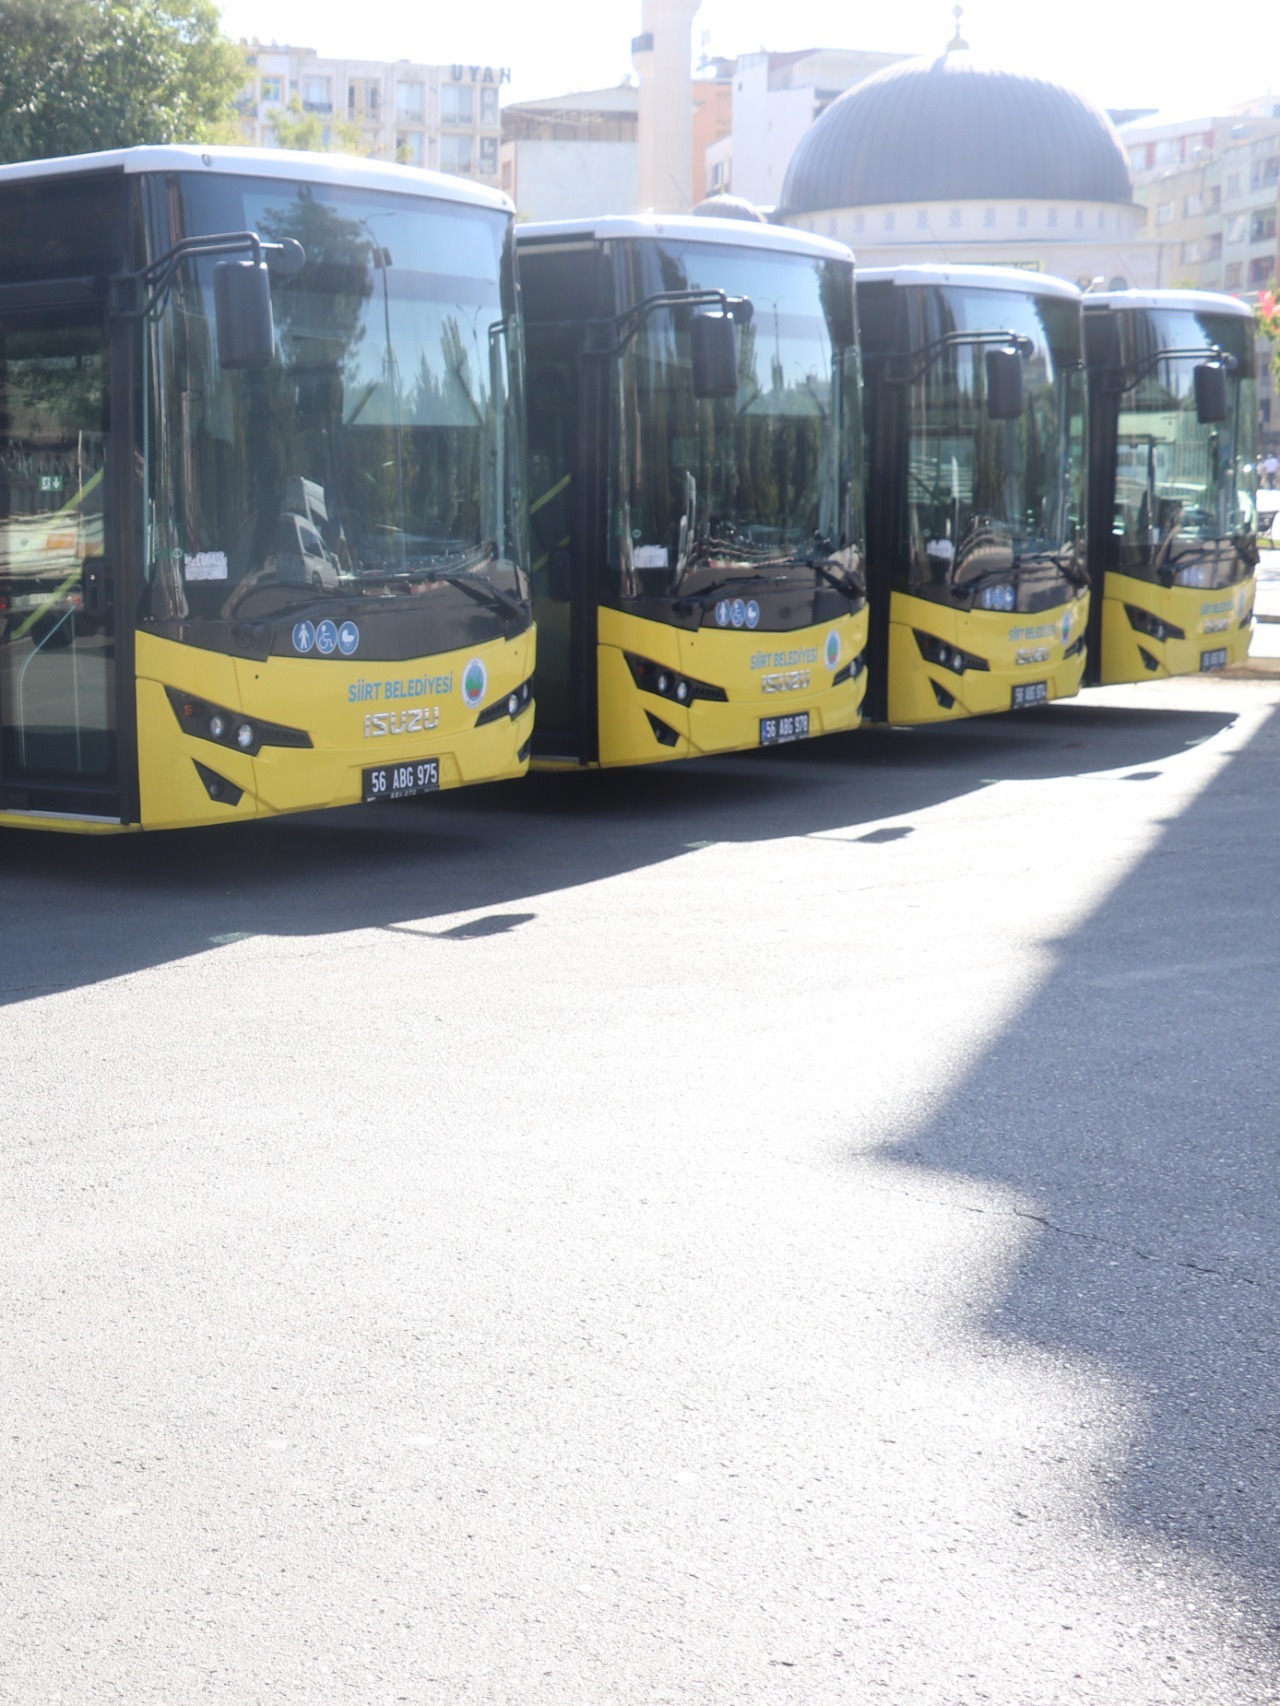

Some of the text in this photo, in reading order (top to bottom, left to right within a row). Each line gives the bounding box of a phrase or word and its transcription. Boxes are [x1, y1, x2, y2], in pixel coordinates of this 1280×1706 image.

[452, 64, 511, 84] UYAN
[348, 671, 453, 702] SİİRT BELEDİYESİ
[364, 707, 439, 737] ISUZU
[766, 720, 776, 737] 56
[372, 763, 437, 792] 56 ABG 975
